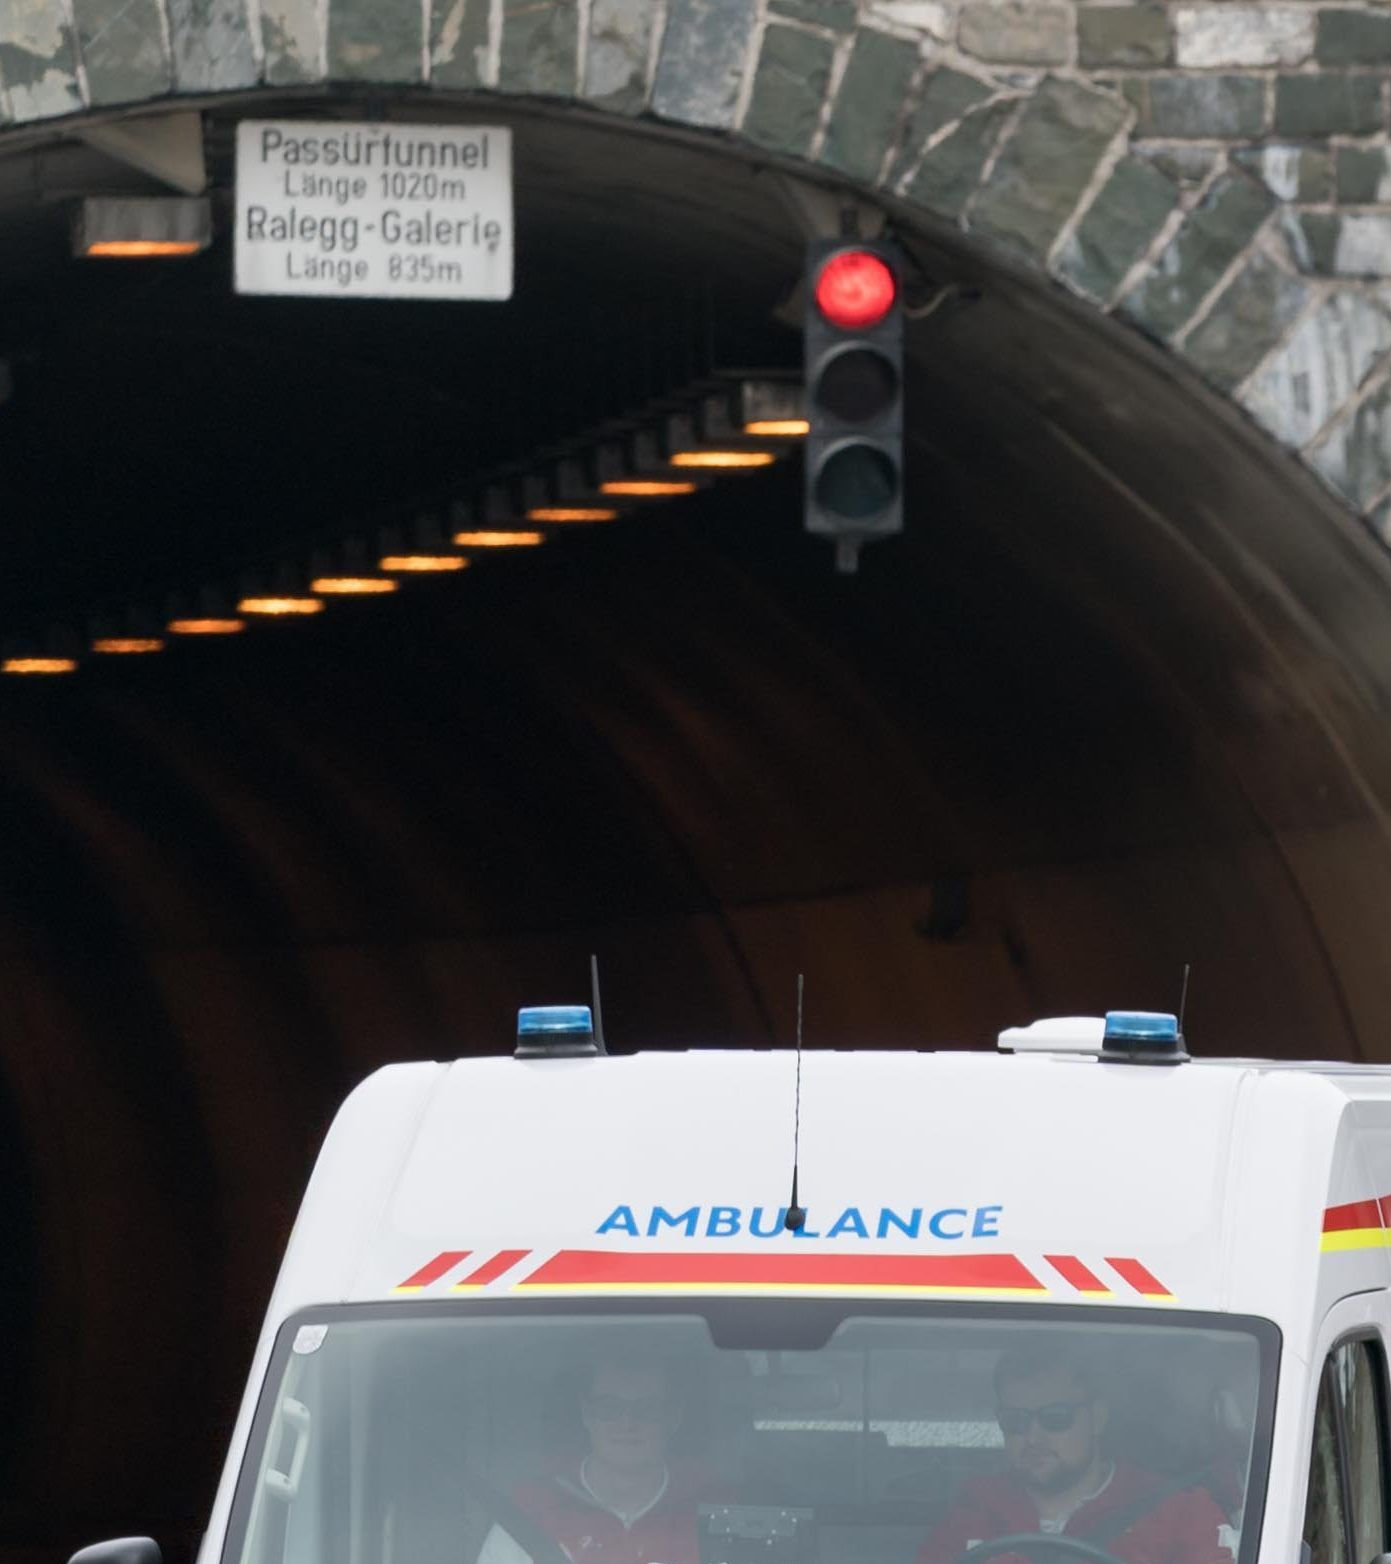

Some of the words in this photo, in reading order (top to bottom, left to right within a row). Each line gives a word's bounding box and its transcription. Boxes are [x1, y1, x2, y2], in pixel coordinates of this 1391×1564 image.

[261, 127, 489, 169] Passürtunnel
[283, 168, 368, 206] Länge
[380, 171, 467, 201] 1020m
[246, 205, 502, 254] Ralegg-Galerie
[286, 251, 369, 288] Länge
[388, 254, 463, 283] 835m
[595, 1204, 1004, 1240] AMBULANCE
